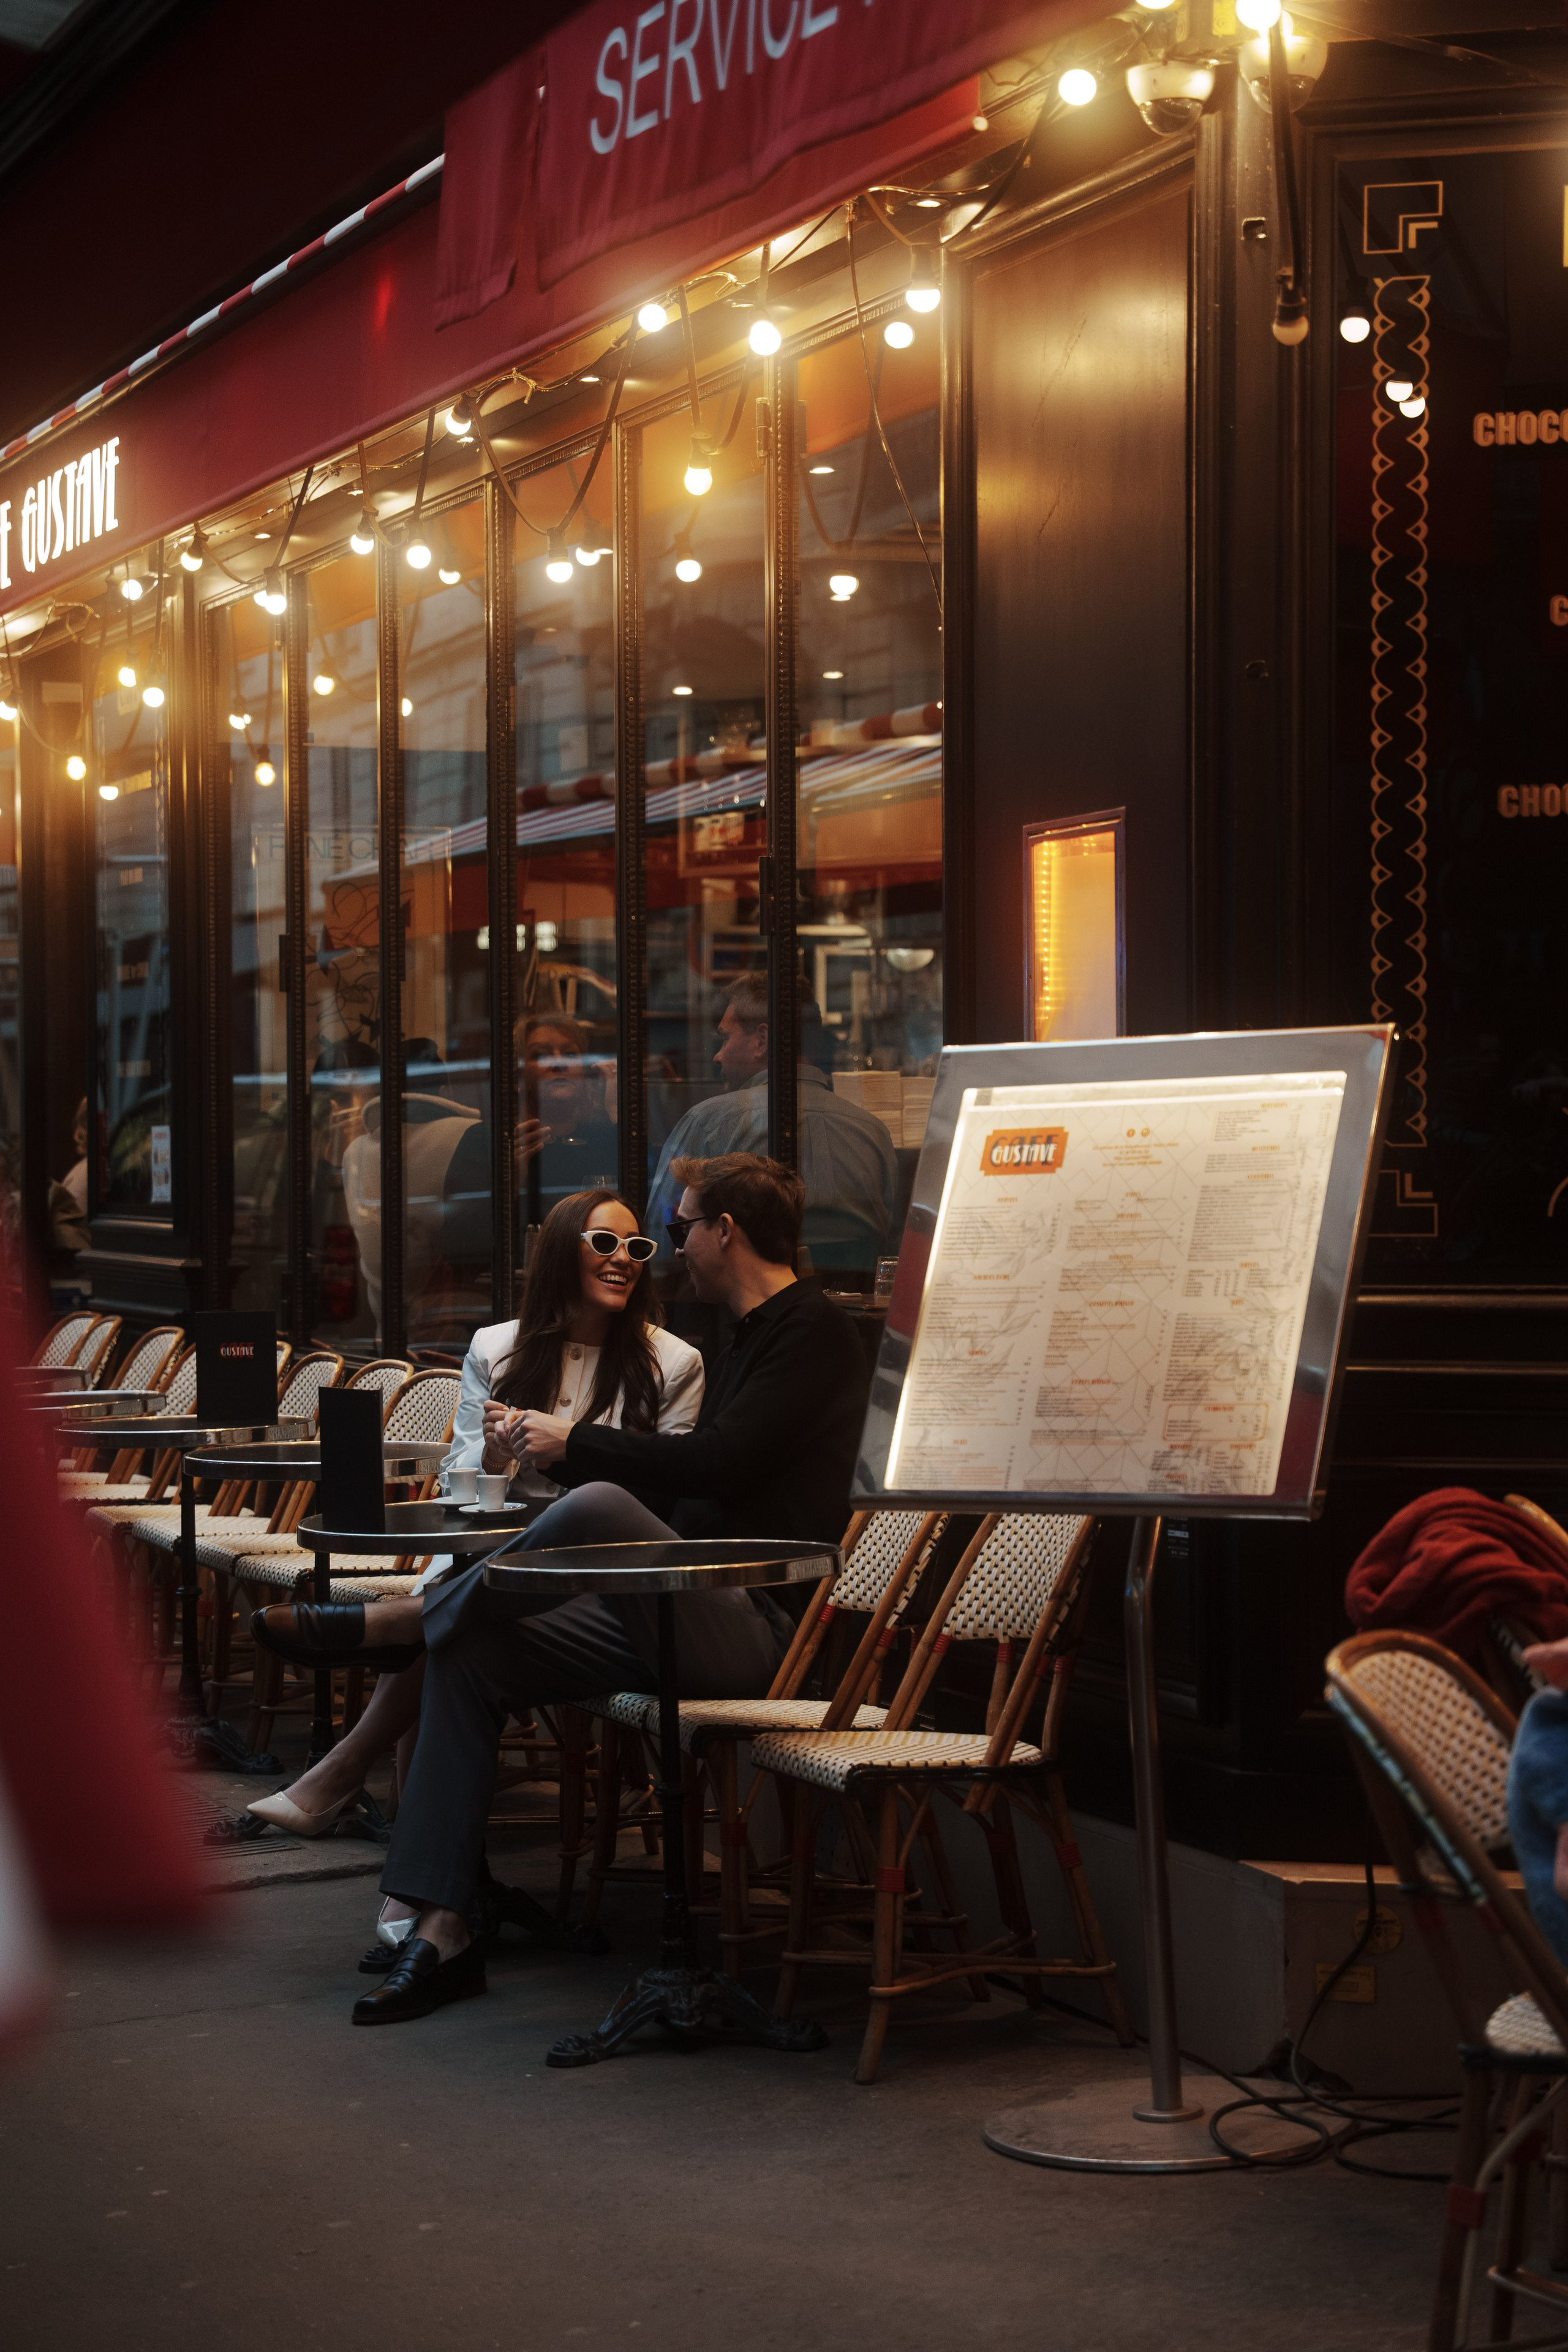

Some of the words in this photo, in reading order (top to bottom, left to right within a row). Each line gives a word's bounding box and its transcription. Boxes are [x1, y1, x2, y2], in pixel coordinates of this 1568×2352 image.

[21, 436, 120, 573] GUSTAVE
[991, 1143, 1058, 1165] GUSTAVE
[221, 1346, 254, 1356] GUSTAVE
